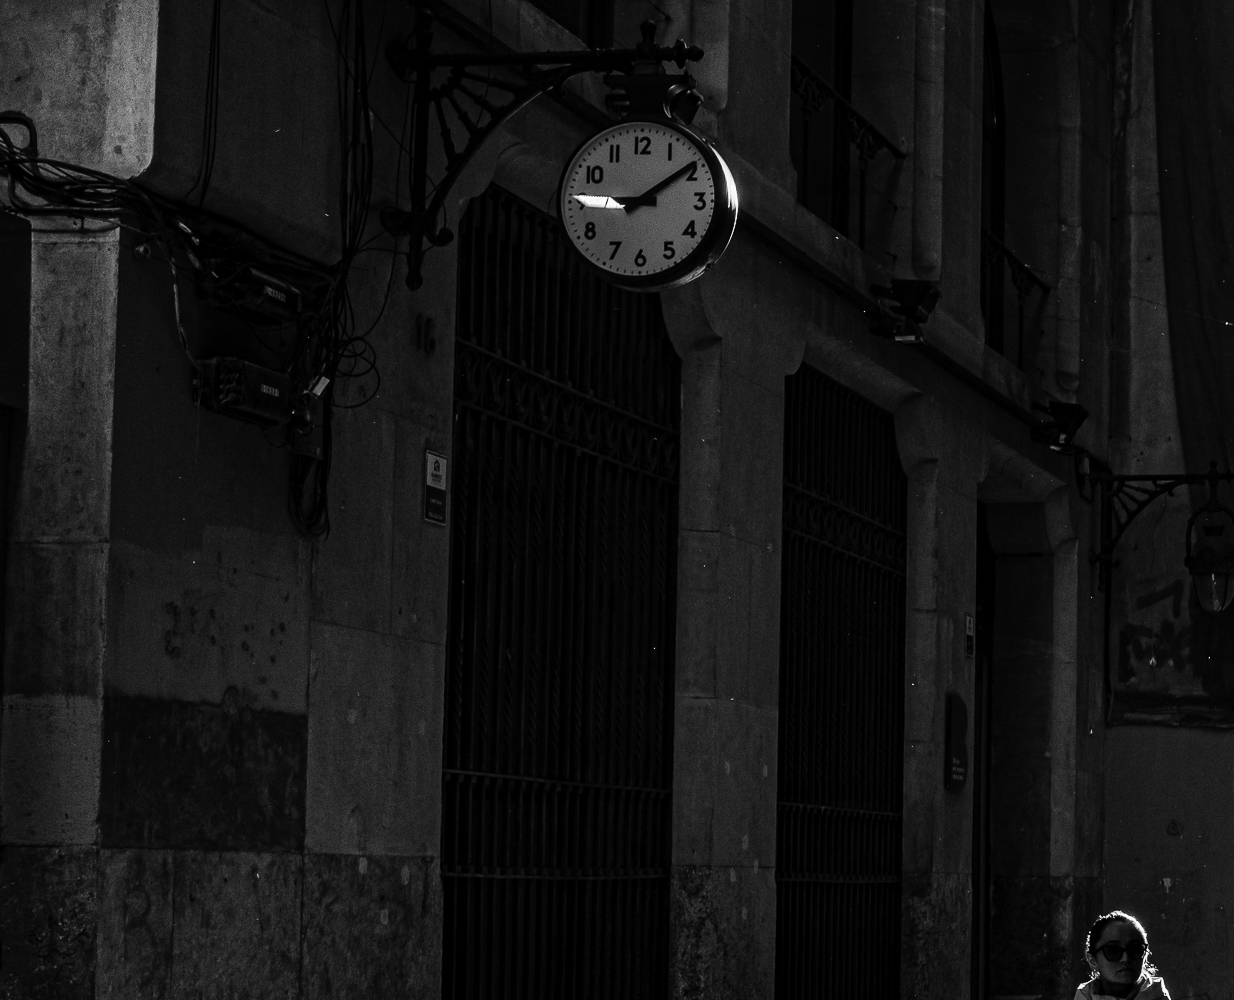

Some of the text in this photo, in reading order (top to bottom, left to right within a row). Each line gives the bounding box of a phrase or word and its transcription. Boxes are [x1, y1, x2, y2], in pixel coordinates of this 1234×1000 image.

[609, 144, 620, 163] 11
[634, 136, 651, 155] 12
[667, 142, 672, 161] 1
[586, 165, 604, 184] 10
[693, 192, 706, 210] 3
[584, 221, 596, 240] 8
[681, 219, 697, 239] 4
[609, 241, 622, 260] 7
[634, 248, 647, 267] 6
[662, 241, 675, 260] 5
